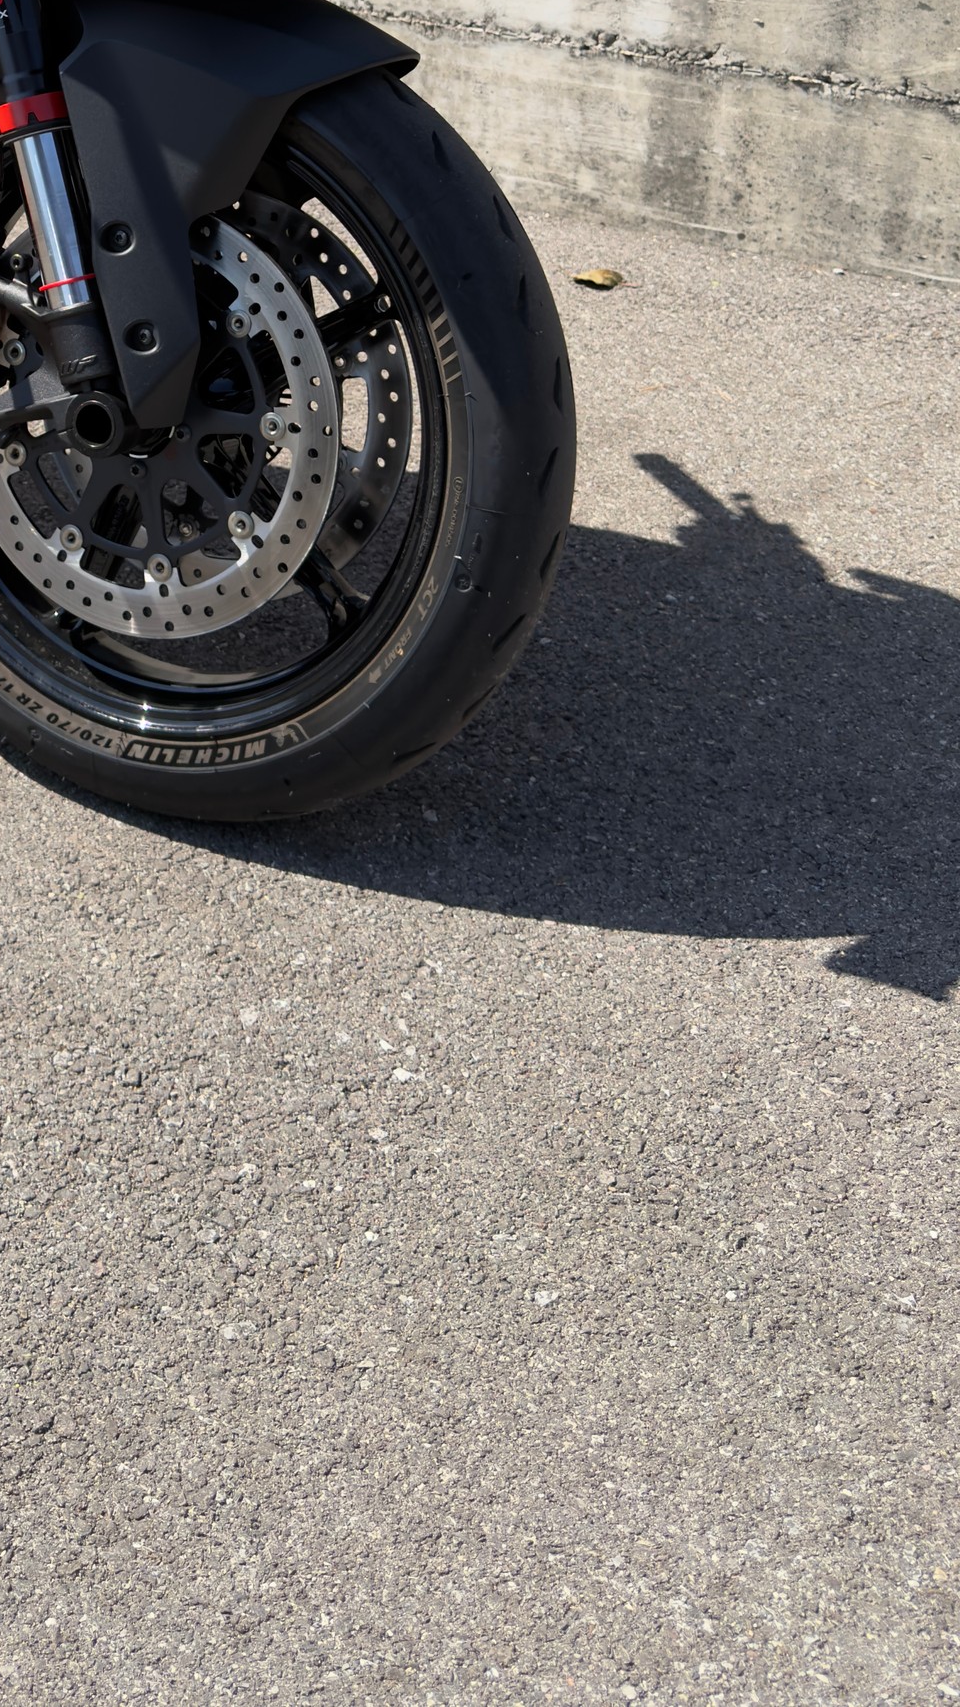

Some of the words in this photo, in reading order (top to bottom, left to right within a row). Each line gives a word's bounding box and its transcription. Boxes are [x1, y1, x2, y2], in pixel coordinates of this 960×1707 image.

[418, 576, 438, 622] 2CT
[15, 693, 44, 715] ZR
[45, 711, 113, 750] 120/70
[126, 738, 268, 765] MICHELIN
